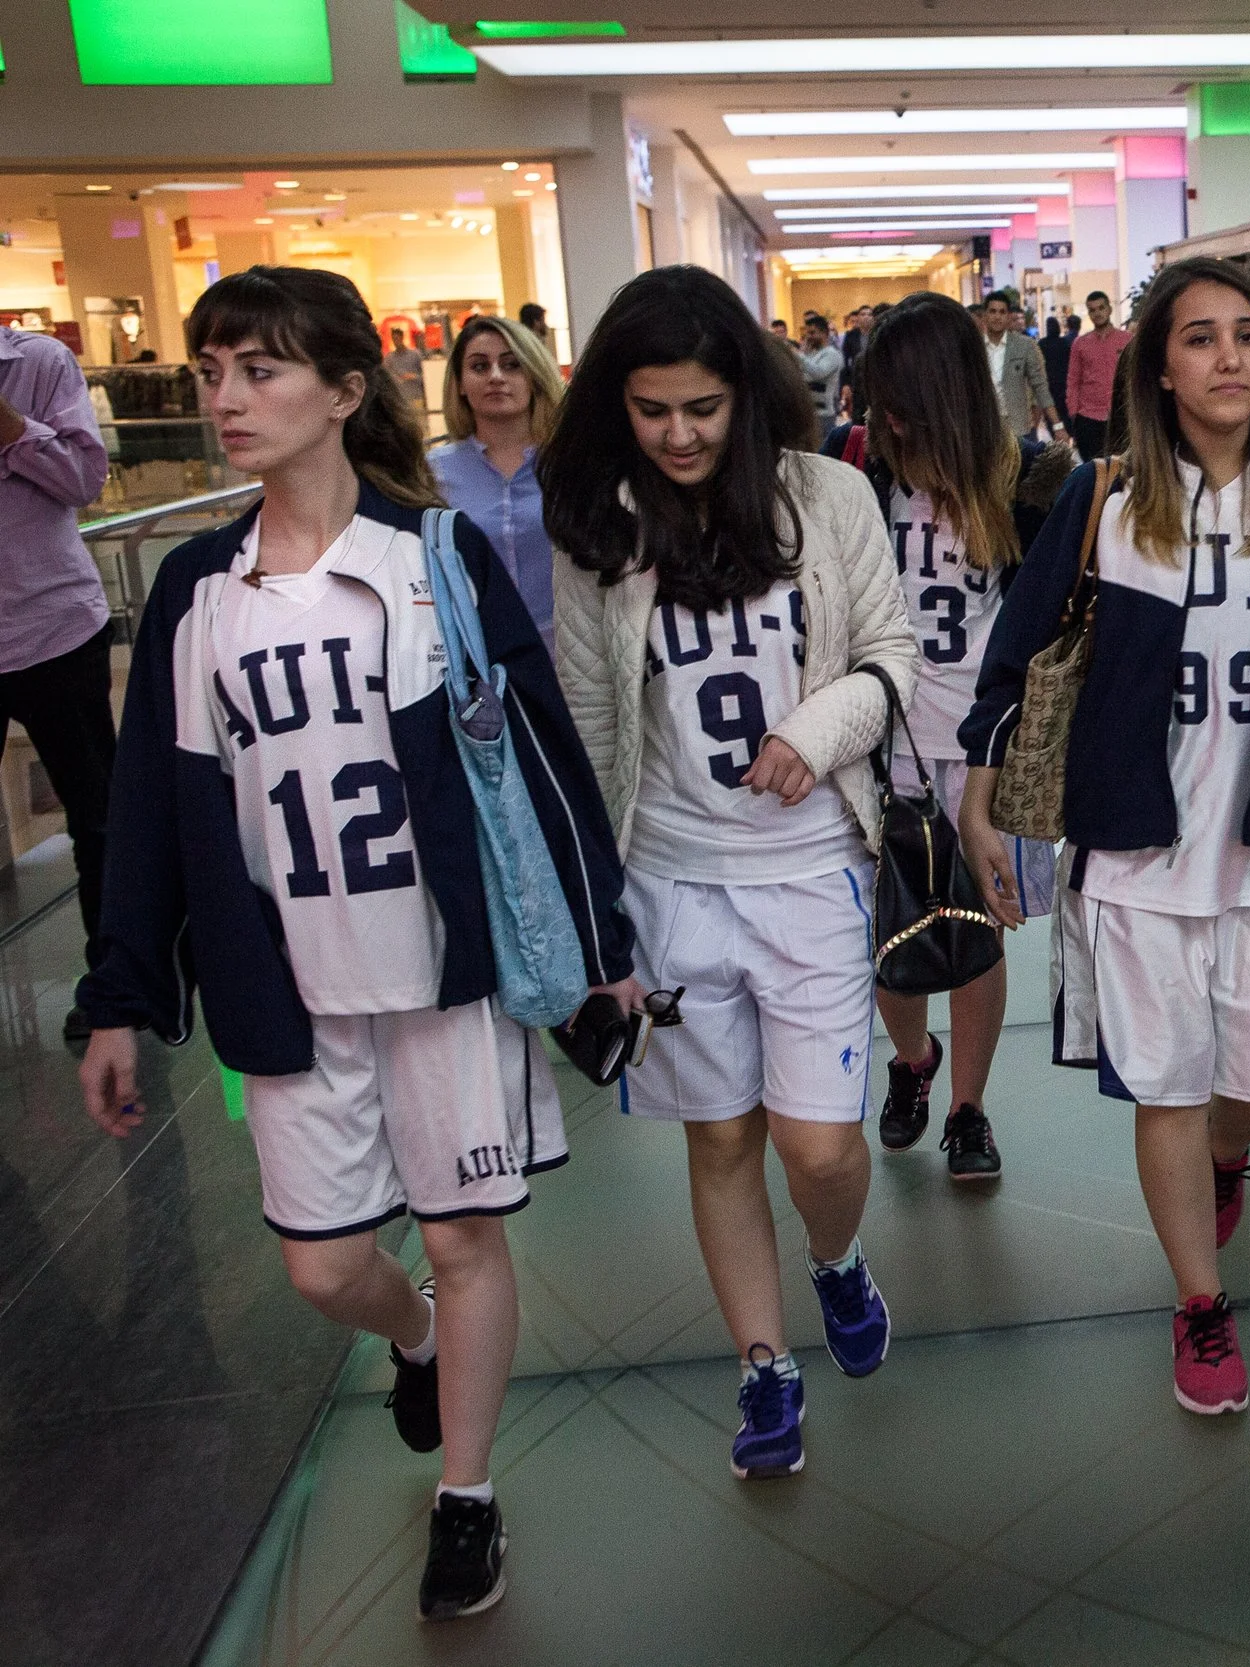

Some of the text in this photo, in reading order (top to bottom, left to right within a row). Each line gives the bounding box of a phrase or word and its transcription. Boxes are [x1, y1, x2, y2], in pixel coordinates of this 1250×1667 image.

[920, 585, 969, 664] 3
[696, 671, 767, 790] 9
[268, 759, 417, 899] 12
